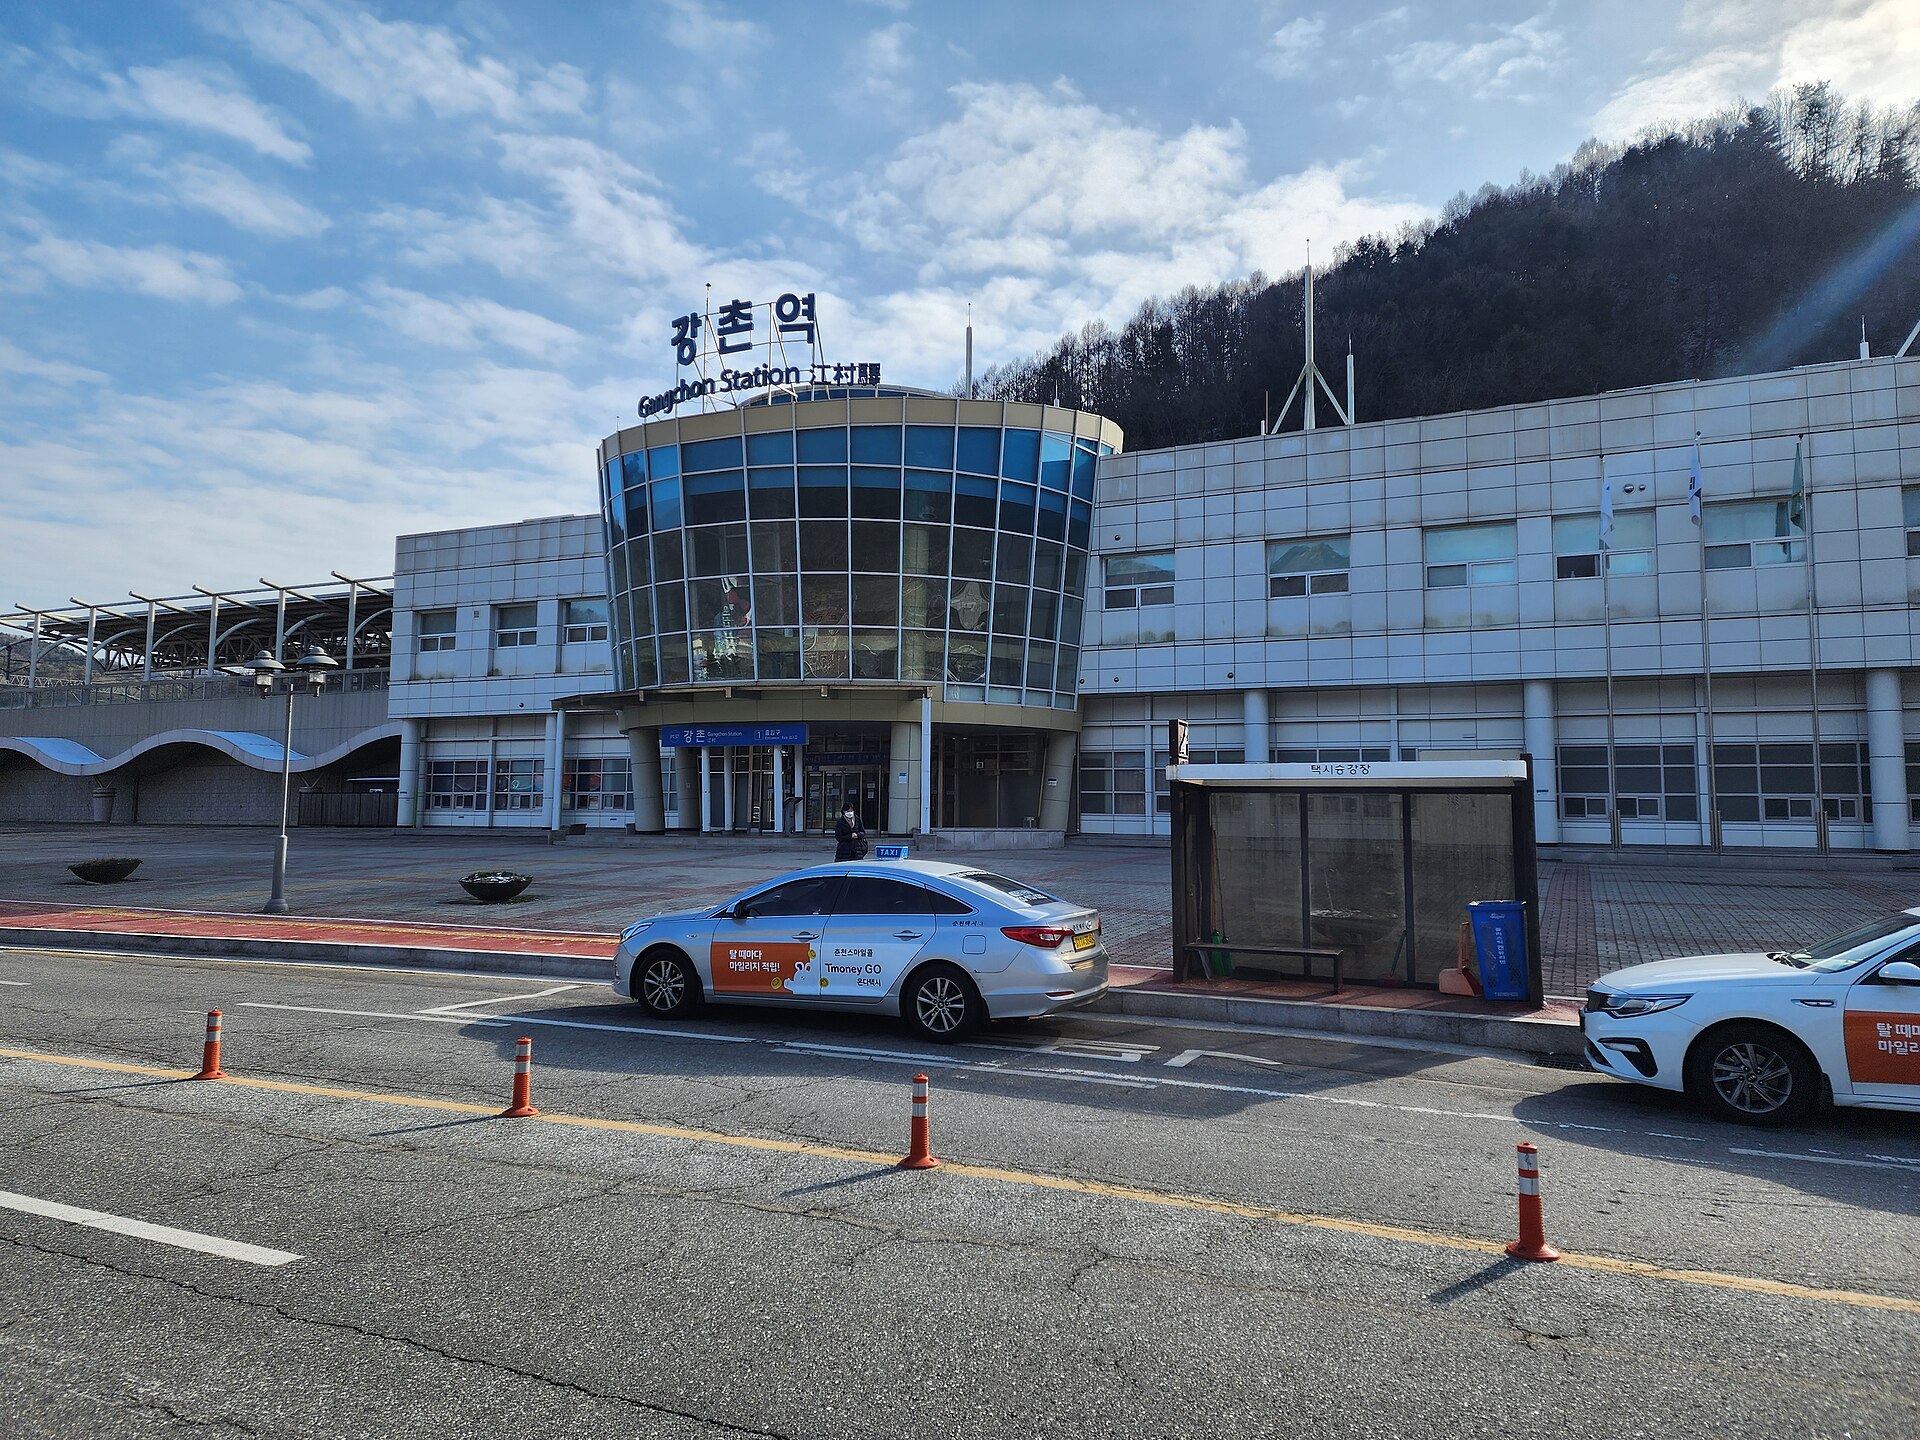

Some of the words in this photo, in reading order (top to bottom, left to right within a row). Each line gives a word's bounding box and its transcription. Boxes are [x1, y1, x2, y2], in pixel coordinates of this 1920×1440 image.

[671, 293, 815, 366] 강촌역
[638, 377, 715, 418] Gangchon
[720, 363, 799, 392] Station
[683, 729, 705, 743] 강촌
[1311, 764, 1371, 775] 택시승강장
[729, 949, 738, 960] 탈
[738, 949, 763, 960] 때마다
[729, 961, 760, 972] 마일리지
[761, 961, 780, 972] 적립!
[825, 963, 862, 975] Tmoney
[864, 963, 882, 974] GO
[1876, 1022, 1893, 1038] 탈
